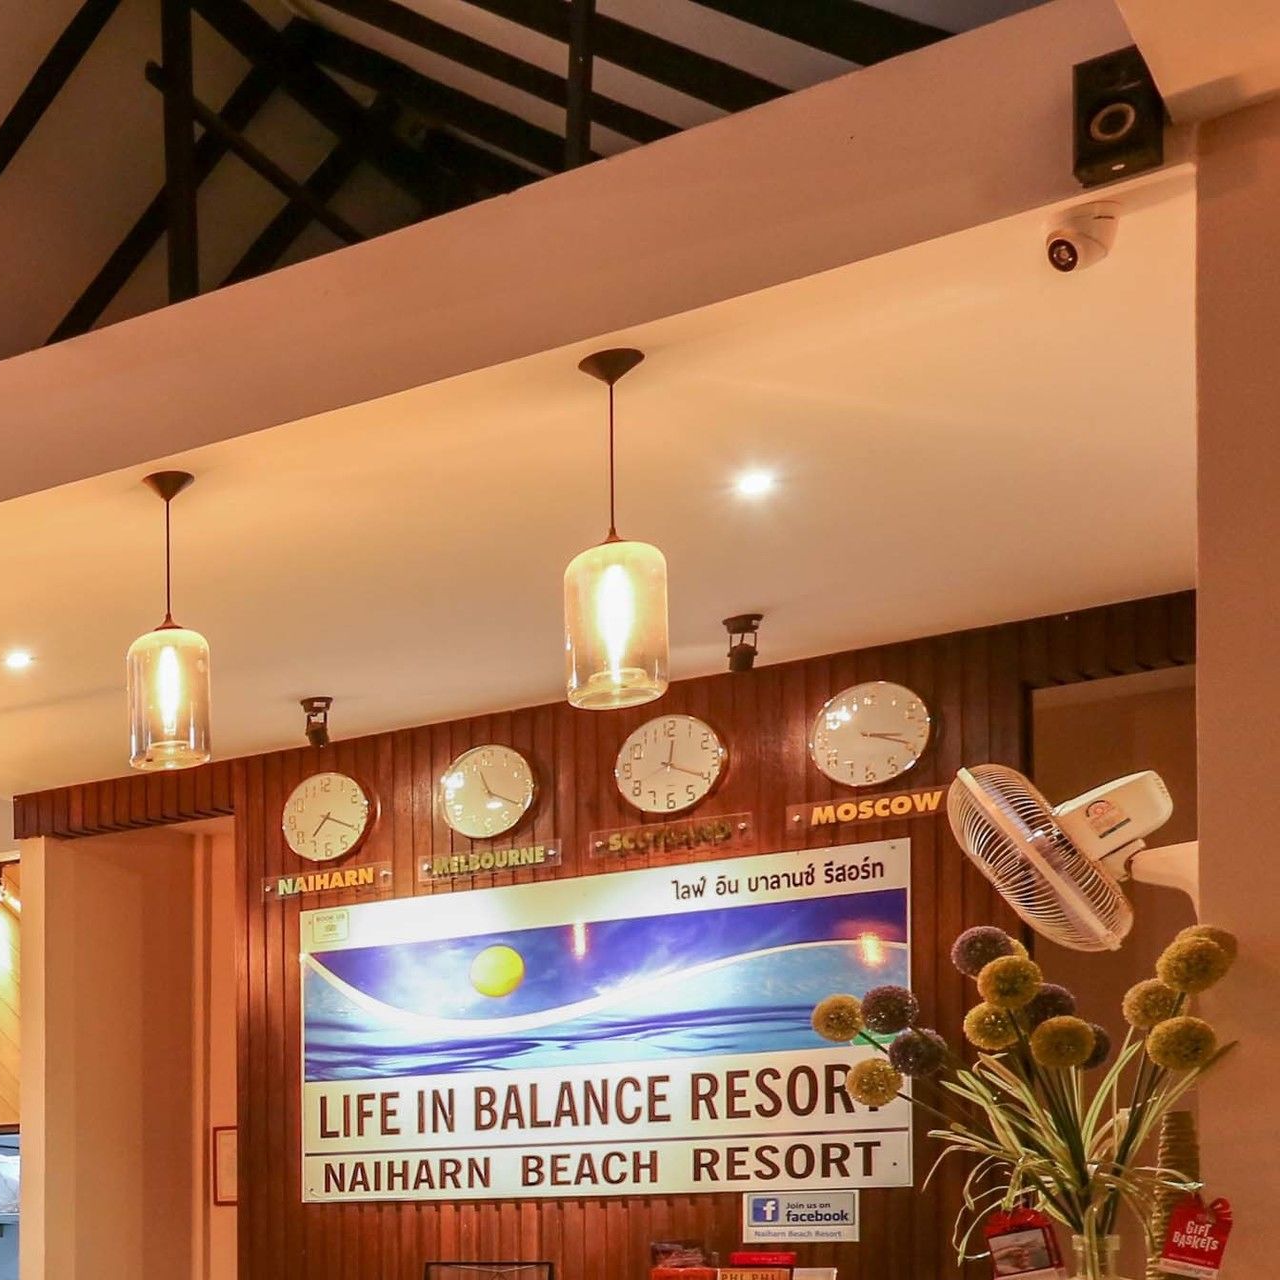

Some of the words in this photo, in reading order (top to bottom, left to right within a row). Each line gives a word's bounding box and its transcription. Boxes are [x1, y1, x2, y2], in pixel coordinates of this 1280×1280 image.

[664, 720, 676, 737] 12
[701, 733, 709, 750] 2
[320, 777, 331, 792] 12
[632, 780, 641, 796] 8
[351, 788, 358, 804] 2
[648, 790, 656, 805] 7
[667, 792, 676, 809] 6
[686, 785, 695, 801] 5
[810, 790, 944, 826] MOSCOW
[325, 842, 333, 857] 6
[340, 835, 348, 849] 5
[433, 846, 545, 876] MELBOURNE
[278, 867, 374, 896] NAIHARN
[715, 875, 739, 896] อิน
[747, 863, 816, 893] บาลานซ์
[823, 857, 885, 885] รีสอร์ท
[319, 1091, 401, 1139] LIFE
[417, 1088, 456, 1133] IN
[474, 1075, 671, 1131] BALANCE
[690, 1063, 879, 1121] RESOR
[324, 1157, 490, 1193] NAIHARN
[521, 1149, 658, 1187] BEACH
[692, 1141, 881, 1183] RESORT
[786, 1202, 805, 1210] Join
[786, 1210, 849, 1222] facebook
[1185, 1221, 1212, 1236] GIFT
[1172, 1231, 1220, 1253] BASKETS
